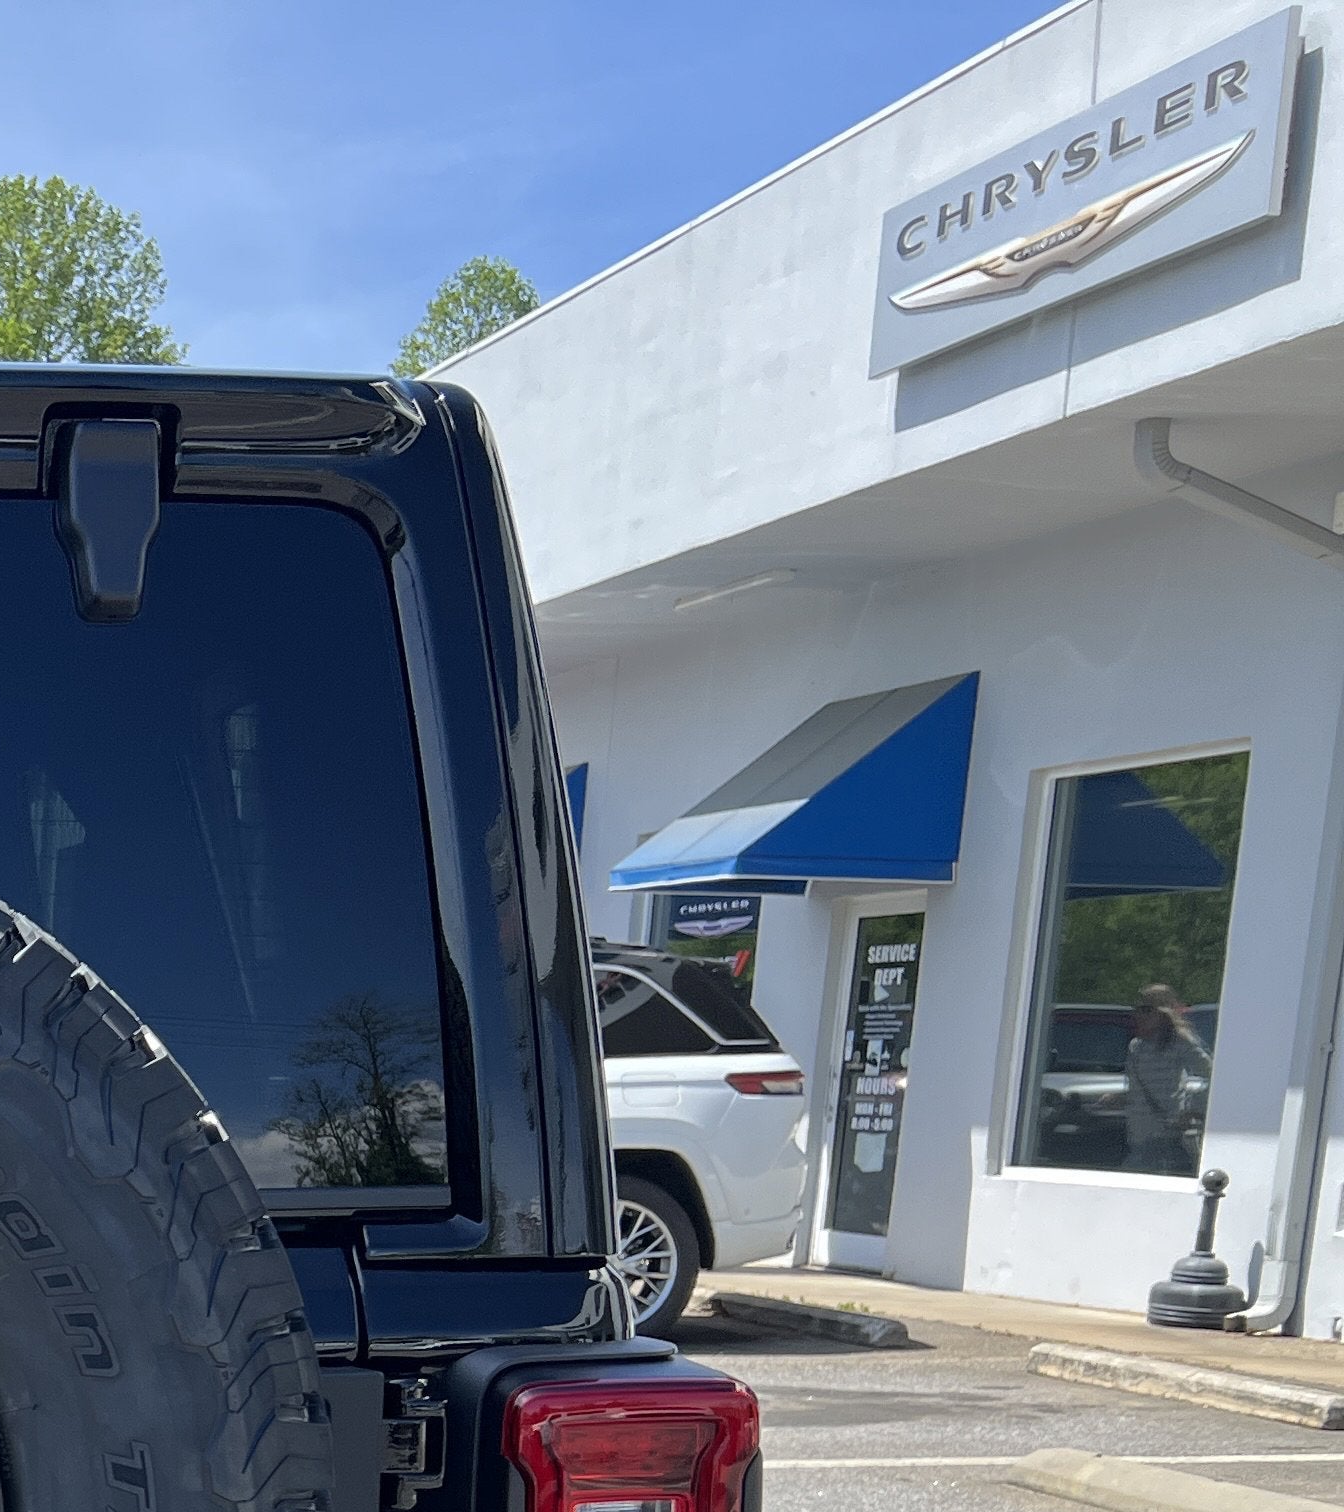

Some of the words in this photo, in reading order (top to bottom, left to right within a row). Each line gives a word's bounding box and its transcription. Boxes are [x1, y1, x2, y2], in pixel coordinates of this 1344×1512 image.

[896, 59, 1249, 260] CHRYSLER
[867, 944, 916, 964] SERVICE
[874, 967, 905, 986] DEPT
[856, 1077, 896, 1095] HOURS
